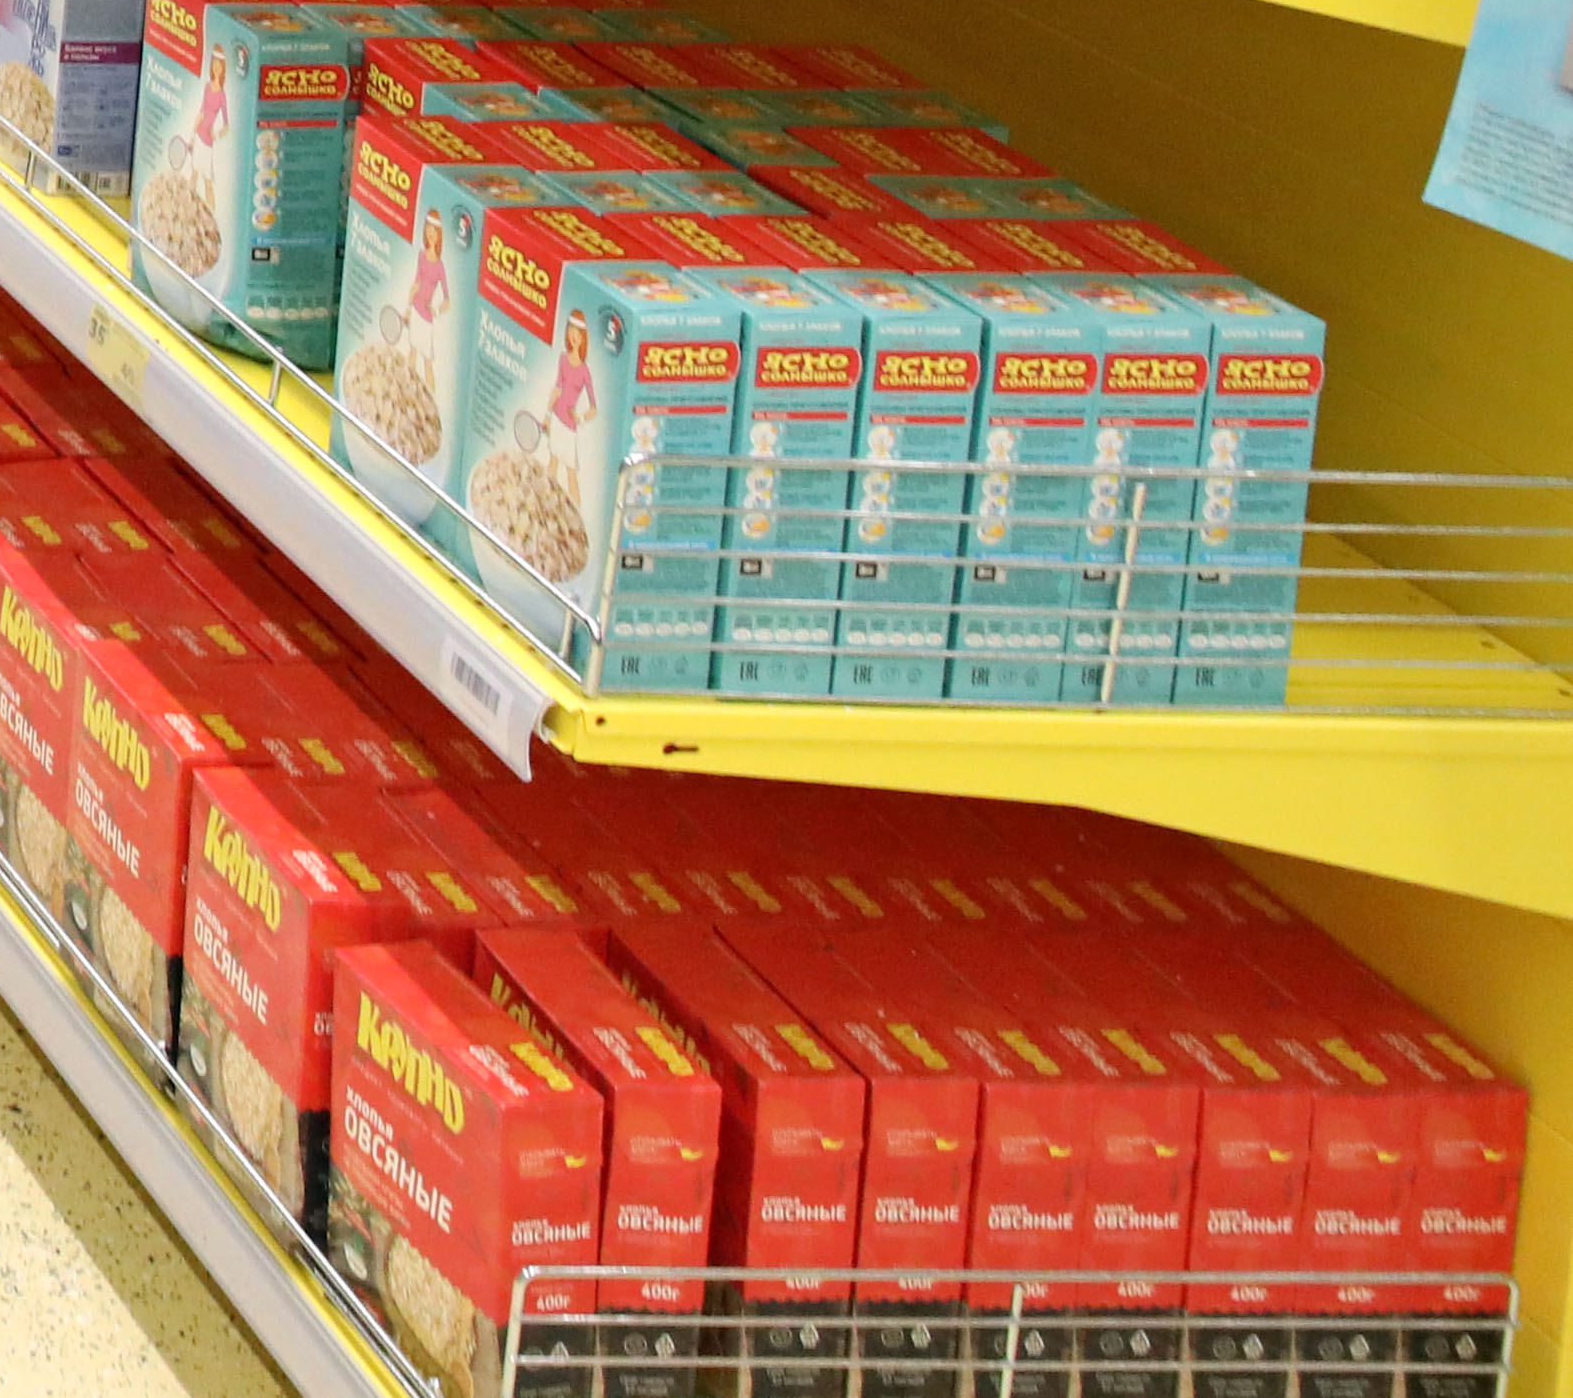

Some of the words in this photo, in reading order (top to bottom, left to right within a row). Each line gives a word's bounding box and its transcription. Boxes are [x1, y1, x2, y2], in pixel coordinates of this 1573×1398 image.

[266, 69, 337, 85] ЯСНО
[360, 141, 411, 190] ЯСНО
[488, 234, 550, 290] ЯСНО
[486, 259, 548, 310] СОЛНЫШКО
[480, 310, 526, 358] Хлопья
[644, 344, 727, 367] ЯСНО
[765, 349, 848, 372] ЯСНО
[882, 354, 968, 376] ЯСНО
[1001, 356, 1086, 378] ЯСНО
[1110, 357, 1196, 379] ЯСНО
[1224, 358, 1311, 380] ЯСНО
[75, 777, 141, 878] ОВСЯНЫЕ
[194, 913, 268, 1024] ОВСЯНЫЕ
[344, 1107, 454, 1235] ОВСЯНЫЕ
[512, 1222, 591, 1246] ОВСЯНЫЕ
[537, 1294, 571, 1311] 400г
[641, 1282, 680, 1302] 400г
